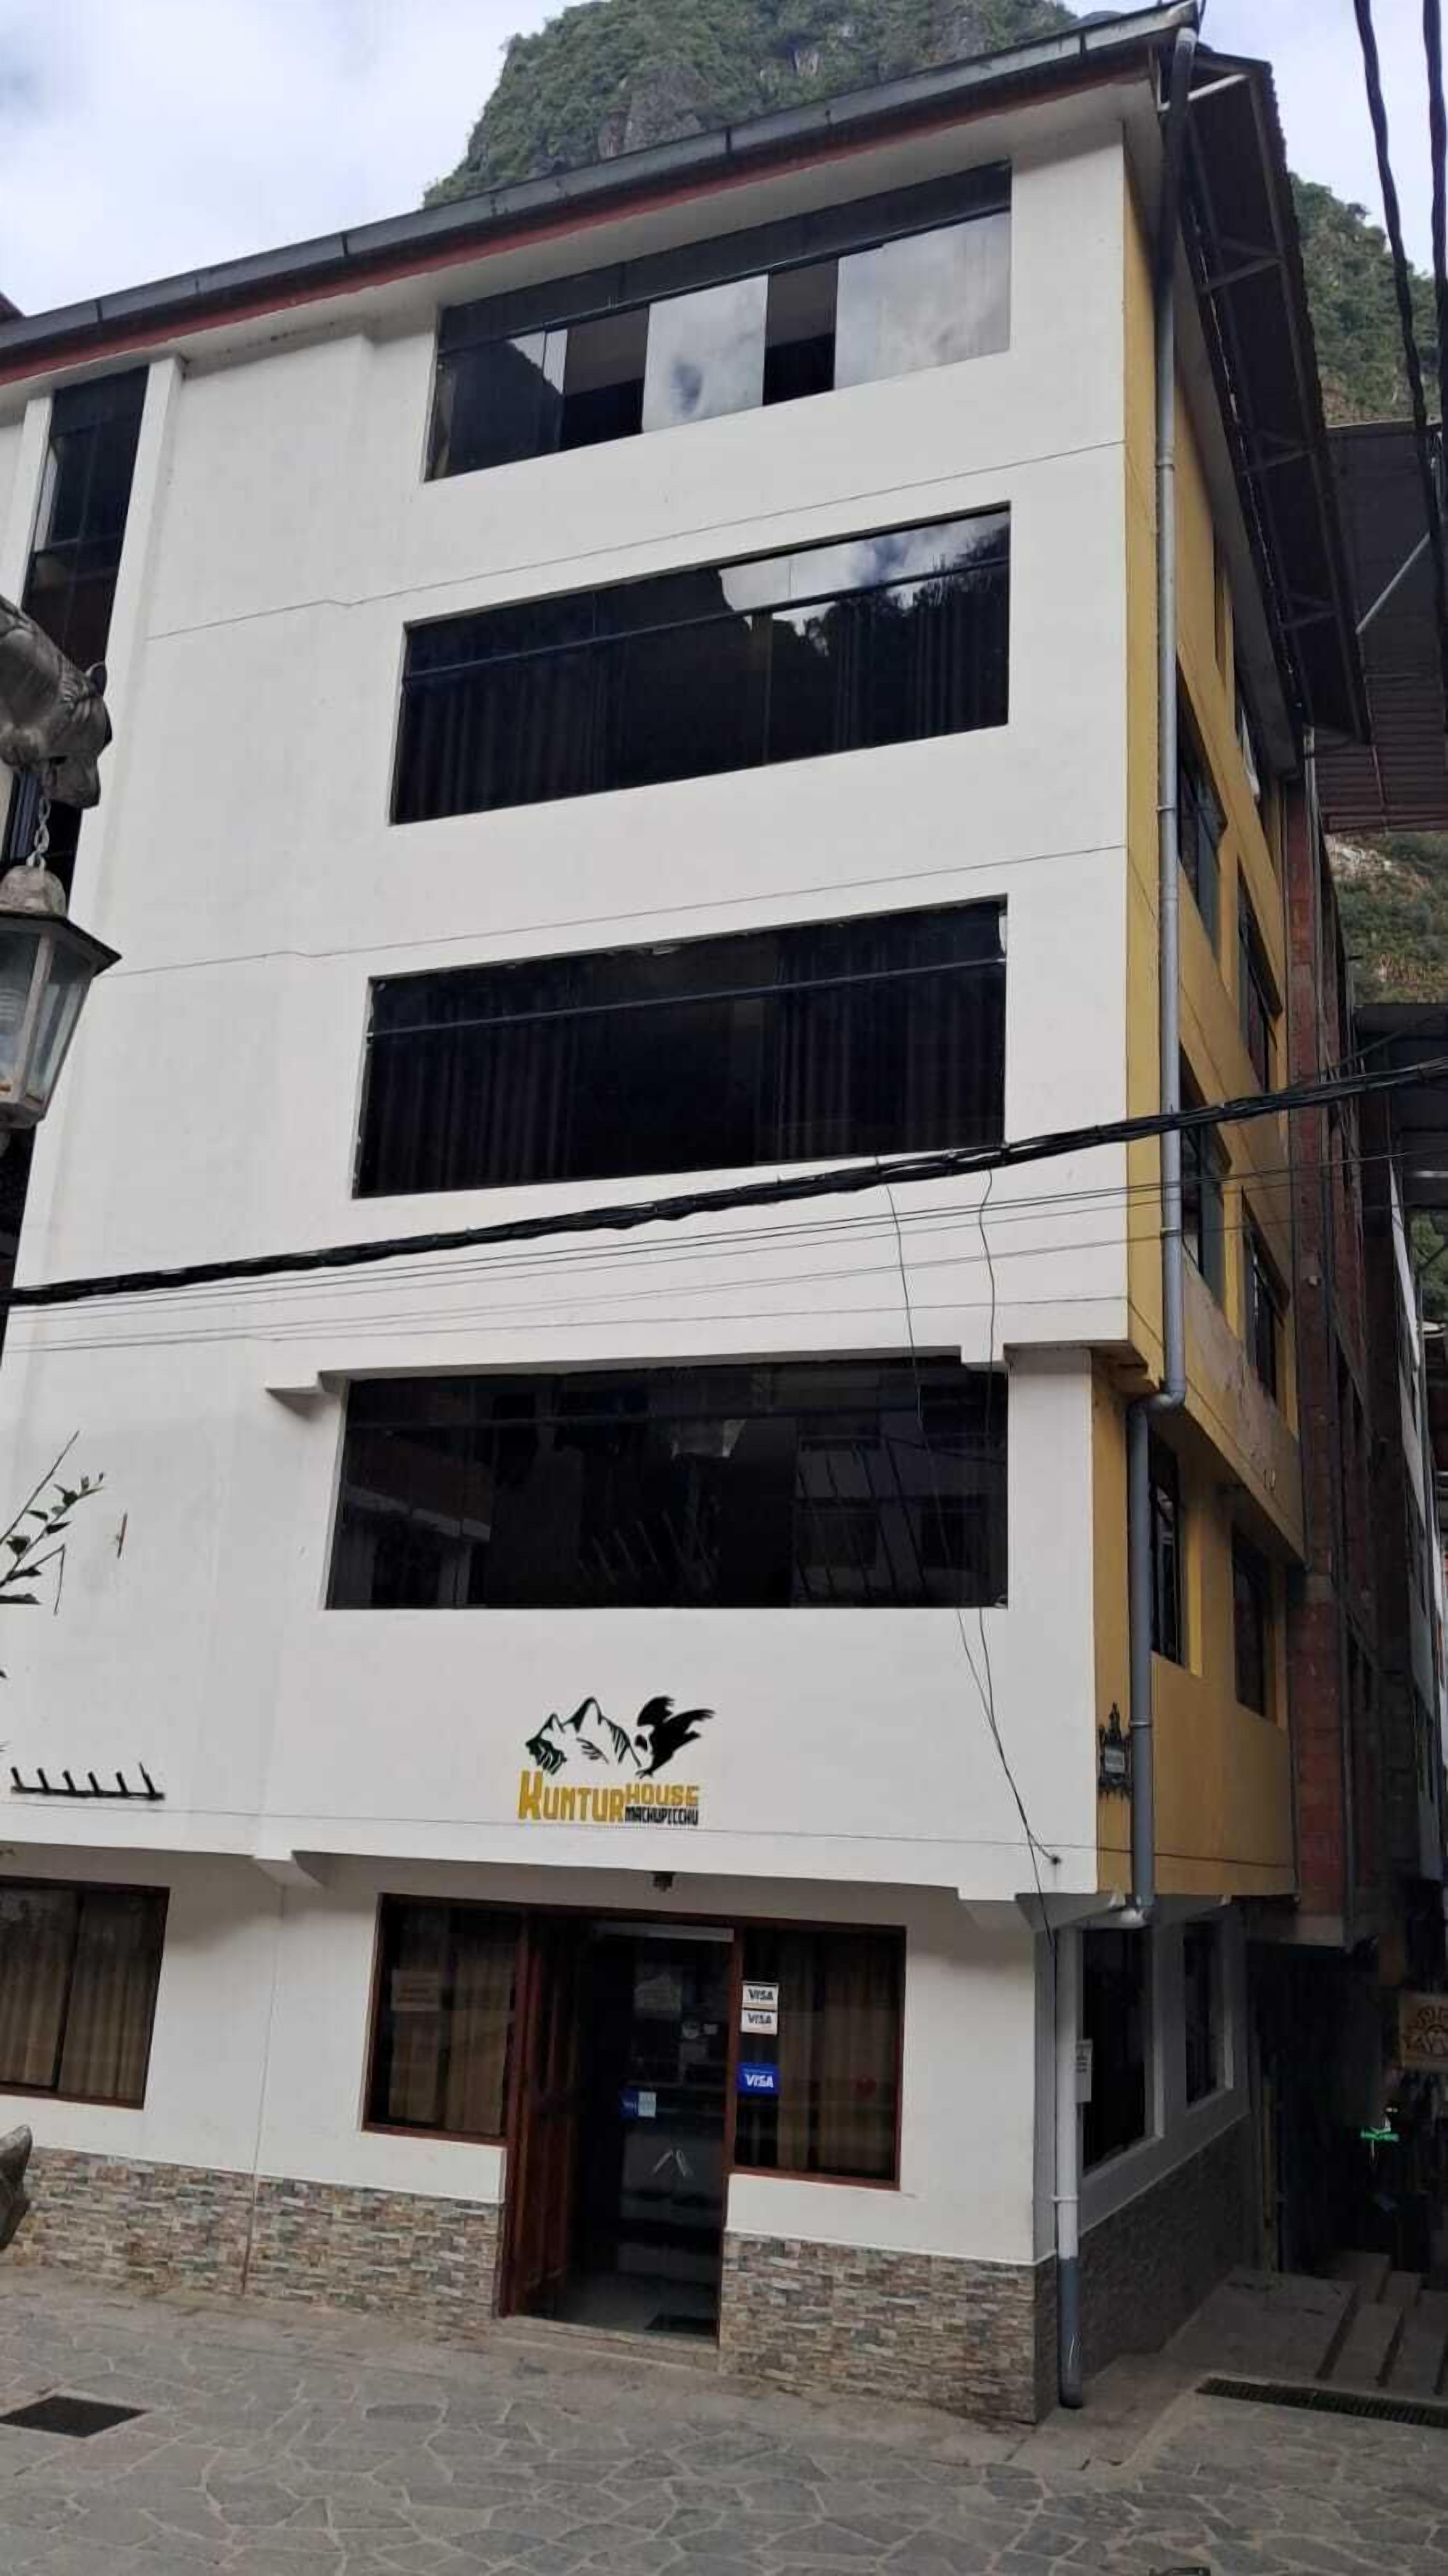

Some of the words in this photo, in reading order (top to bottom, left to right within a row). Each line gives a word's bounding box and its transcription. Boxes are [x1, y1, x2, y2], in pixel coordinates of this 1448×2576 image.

[519, 1770, 625, 1822] KUNTUR
[625, 1783, 699, 1806] HOUSE
[748, 1989, 774, 2000] VISA
[747, 2013, 772, 2024] VISA
[745, 2074, 774, 2088] VISA
